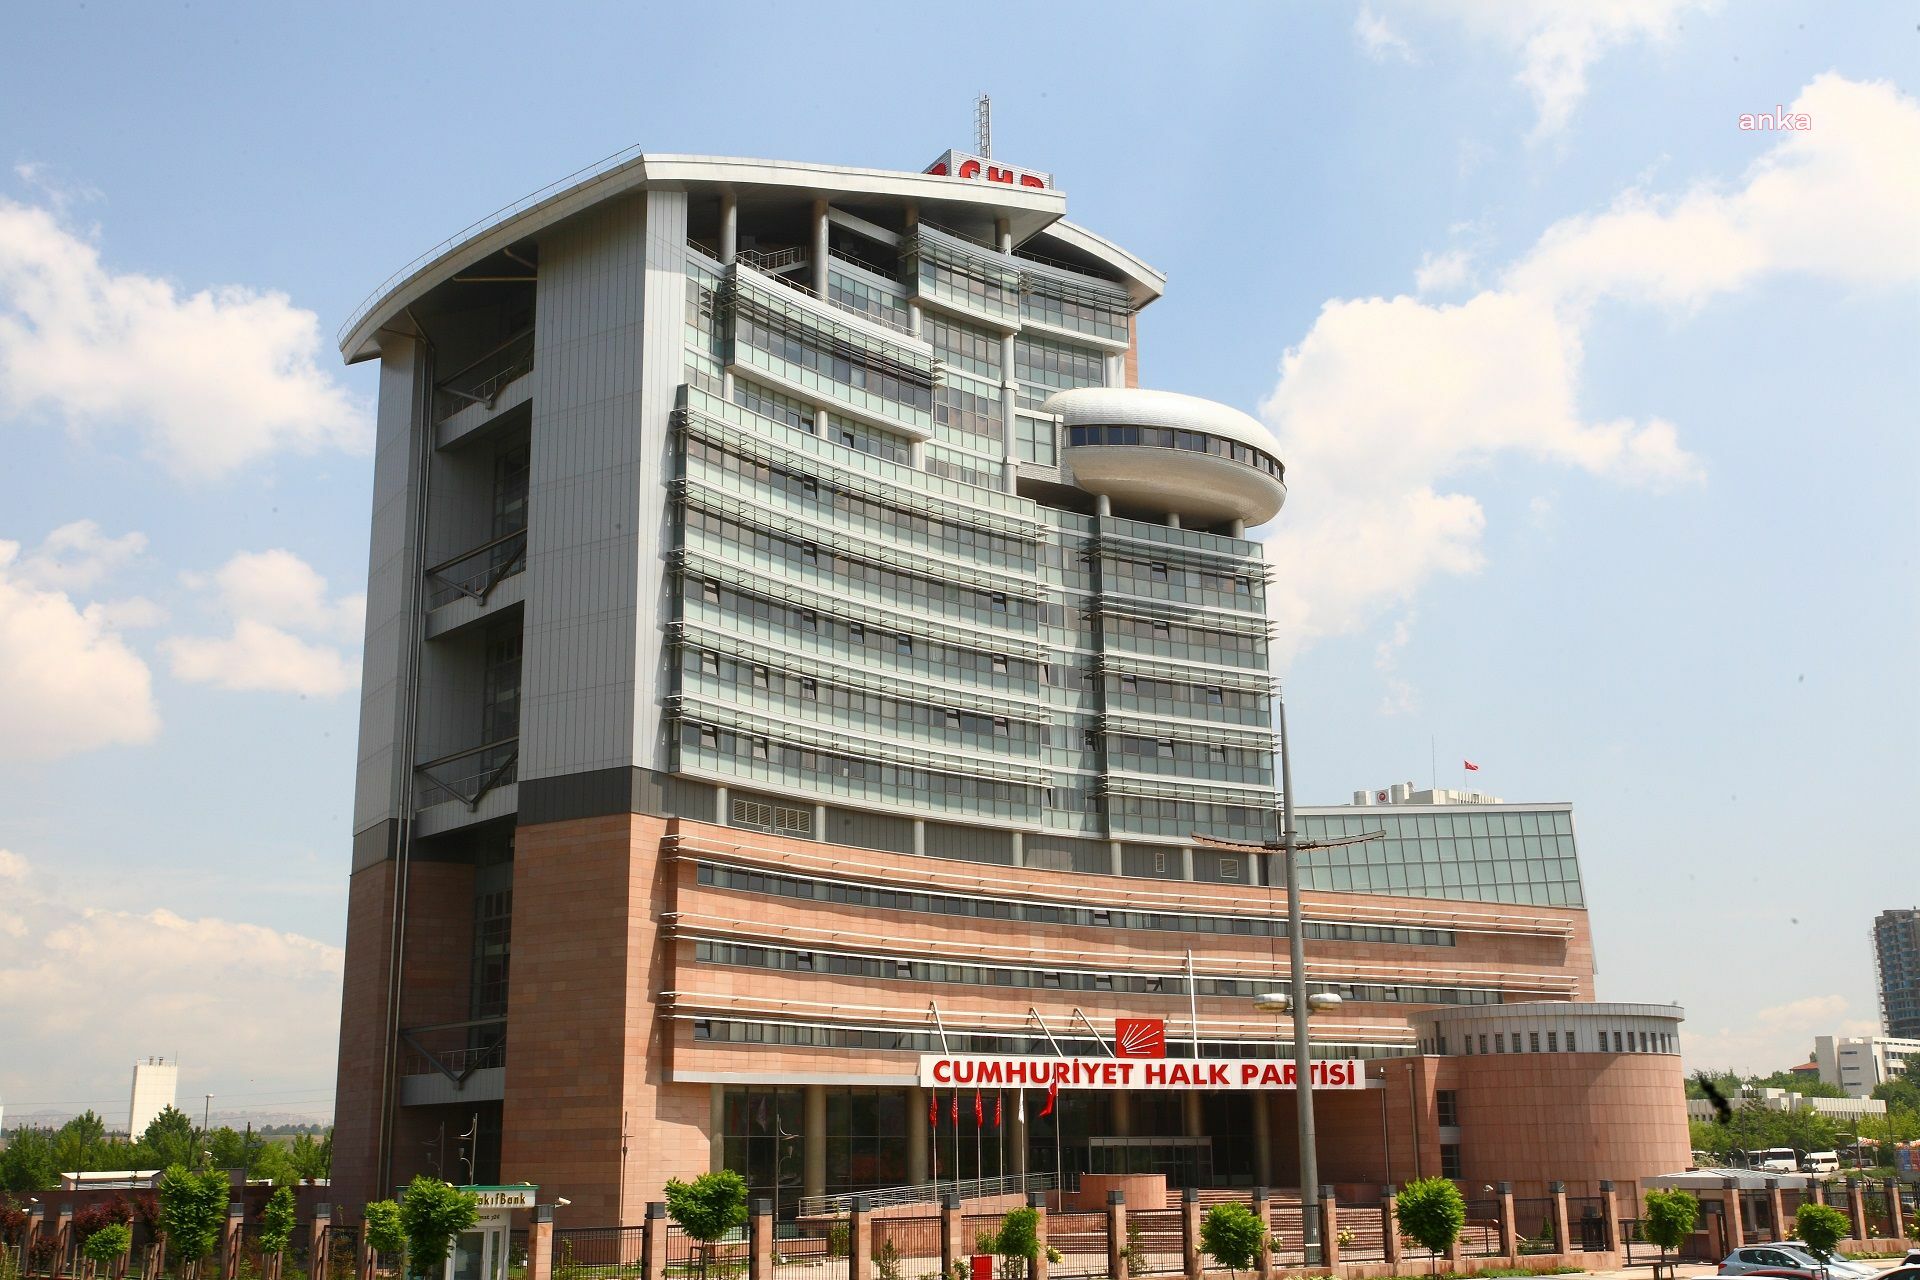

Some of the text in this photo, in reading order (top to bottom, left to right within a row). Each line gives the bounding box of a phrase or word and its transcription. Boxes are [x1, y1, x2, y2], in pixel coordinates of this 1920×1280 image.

[933, 1058, 1355, 1085] CUMHURİYET HALK PARTİSİ
[478, 1192, 526, 1205] akıfBank
